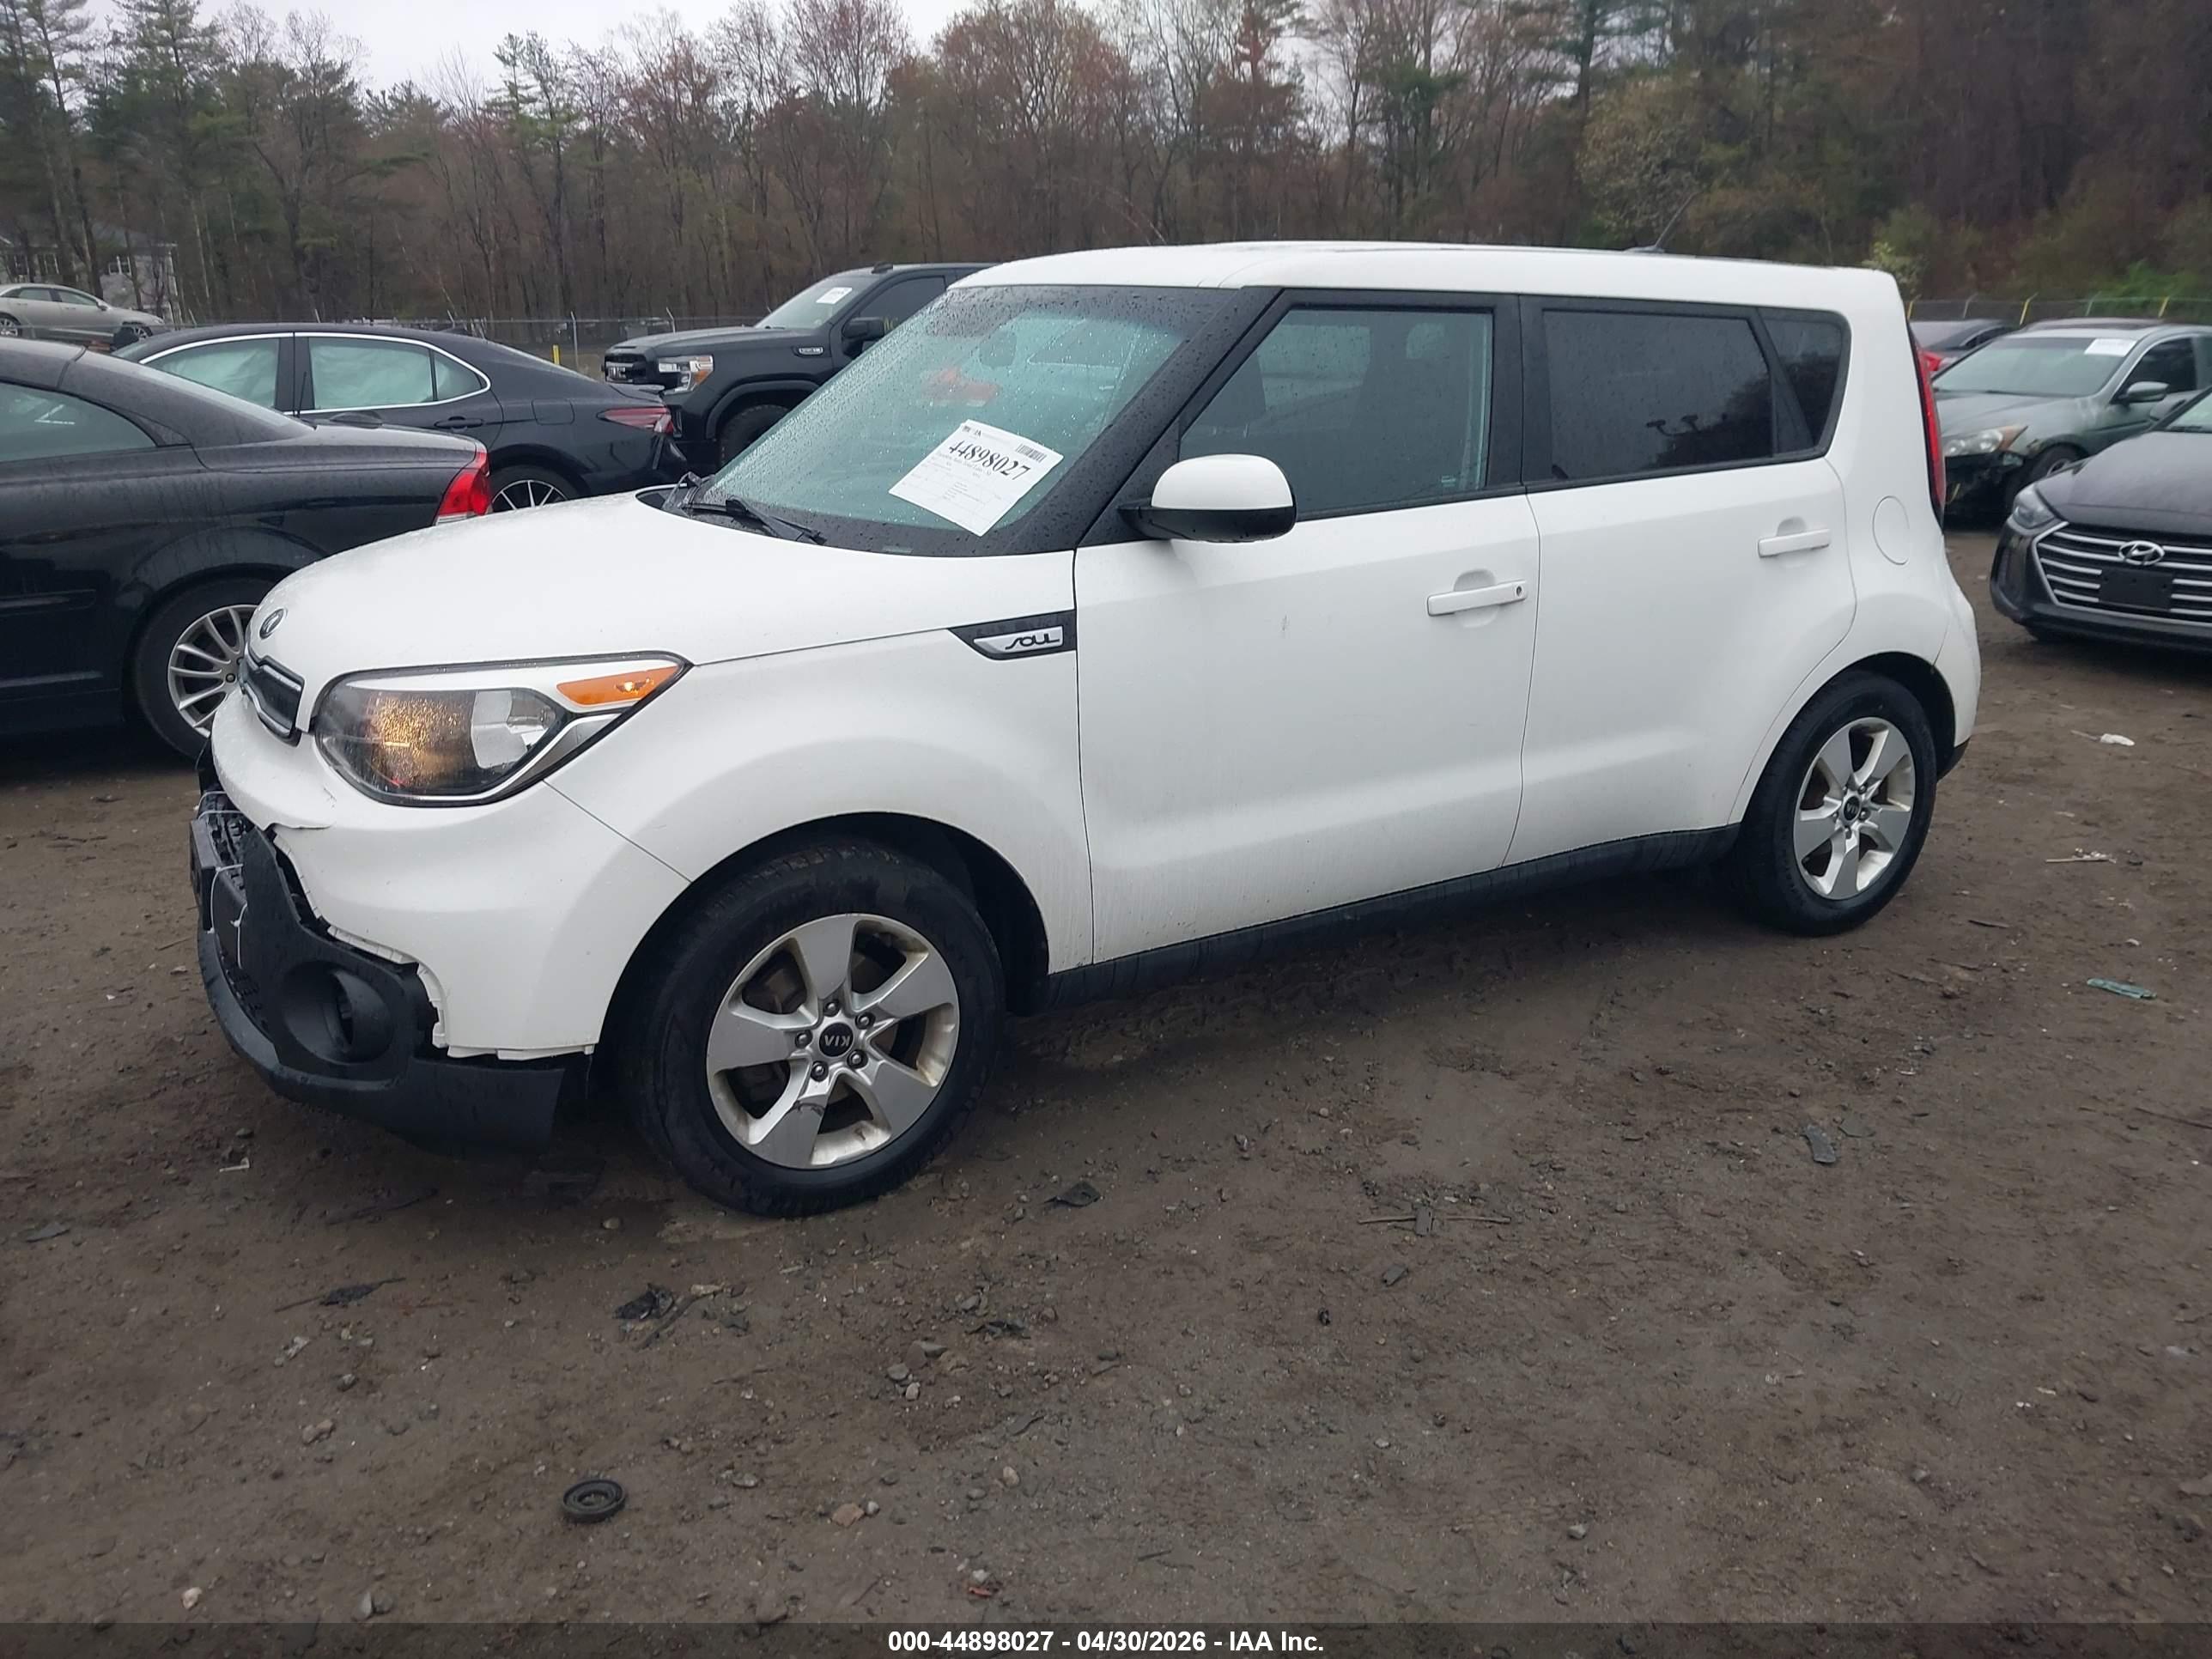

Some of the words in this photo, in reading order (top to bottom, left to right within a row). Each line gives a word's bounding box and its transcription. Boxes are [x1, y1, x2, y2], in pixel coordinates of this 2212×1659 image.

[949, 440, 1030, 480] 44898027
[1005, 633, 1060, 649] SOUL
[824, 1035, 850, 1047] KIA
